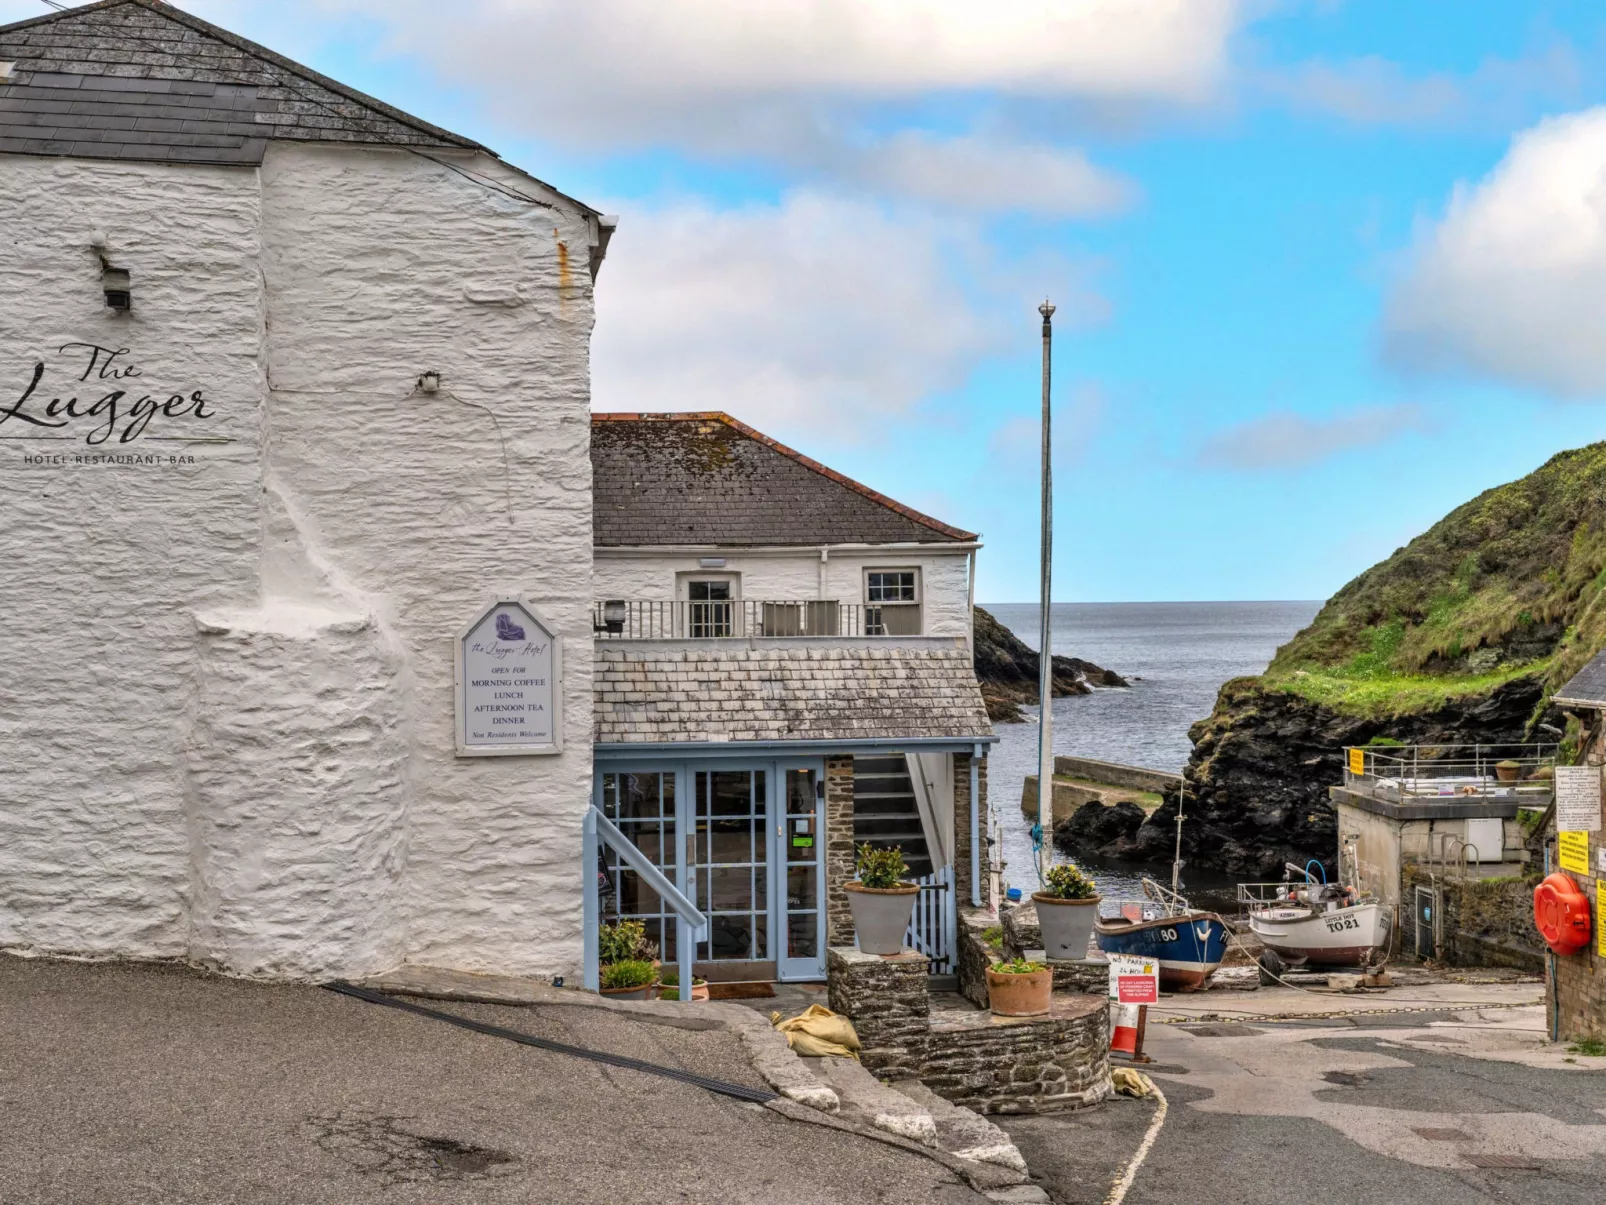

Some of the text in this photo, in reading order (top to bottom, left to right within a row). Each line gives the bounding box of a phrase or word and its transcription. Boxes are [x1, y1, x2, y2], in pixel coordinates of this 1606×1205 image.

[59, 342, 142, 381] The
[0, 362, 215, 444] Lugger
[485, 641, 515, 660] Lugger
[520, 642, 547, 657] Hotel
[471, 679, 546, 687] MORNING COFFEE
[474, 704, 525, 712] AFTERNOON
